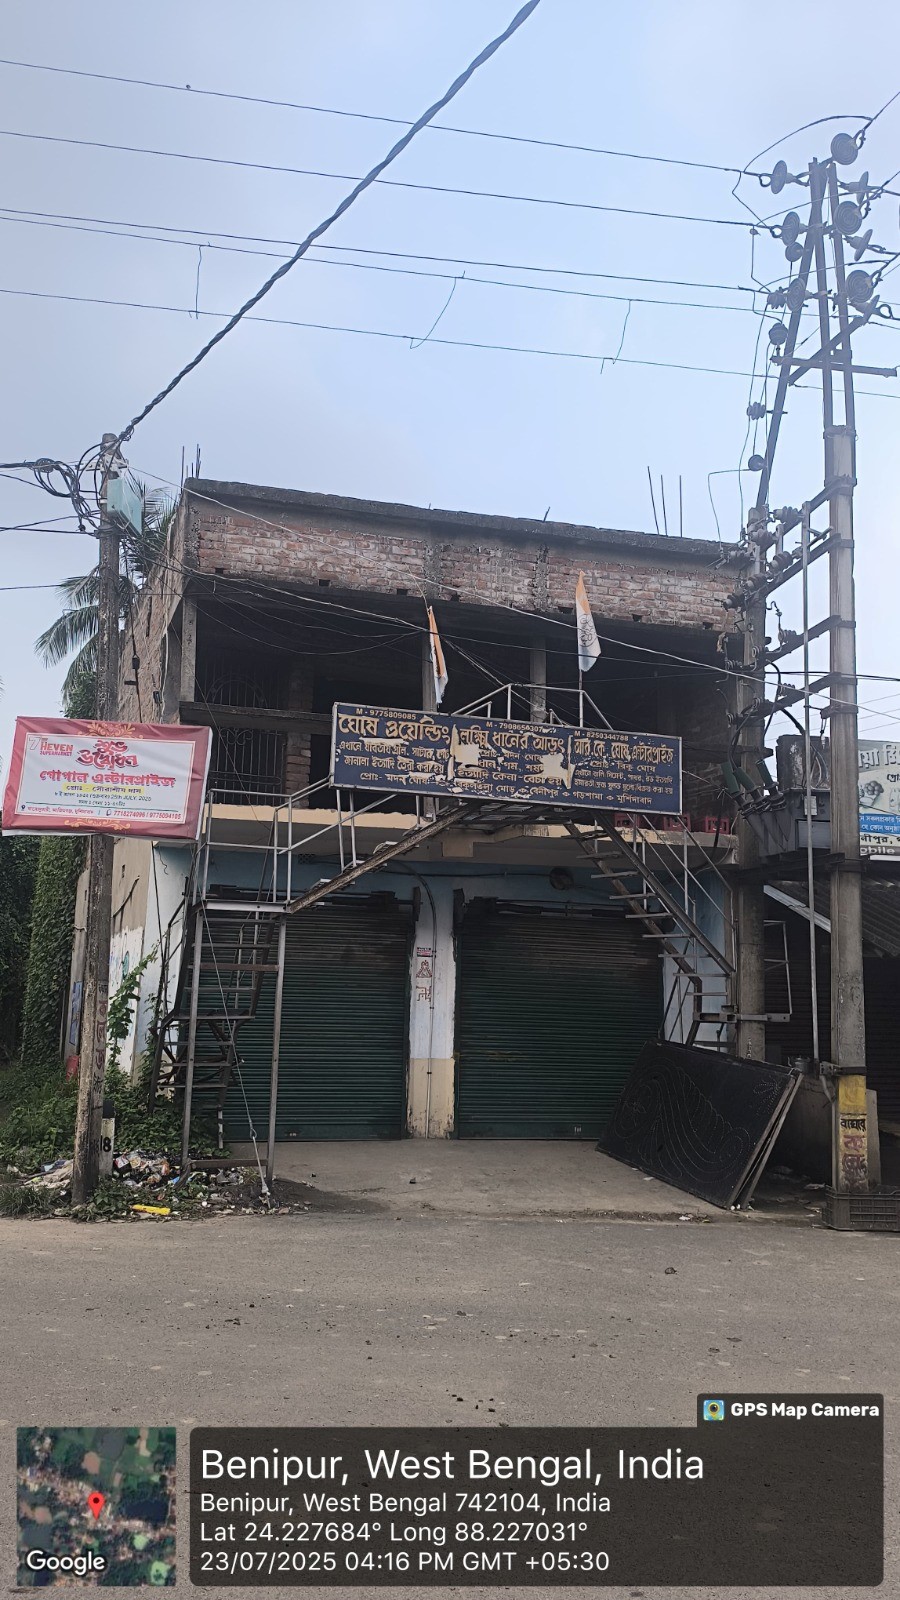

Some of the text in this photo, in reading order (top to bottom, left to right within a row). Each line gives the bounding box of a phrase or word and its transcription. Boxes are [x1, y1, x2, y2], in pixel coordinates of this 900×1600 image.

[356, 708, 363, 716] M
[370, 709, 416, 720] 9775809085
[338, 713, 379, 736] ঘোষ
[93, 739, 129, 755] শুভ
[340, 741, 362, 751] এখানে
[492, 731, 529, 750] ধানের
[344, 755, 369, 767] জানালা
[372, 756, 394, 769] ইত্যাদি
[39, 770, 176, 788] গোপাল এন্টারপ্রাইজ
